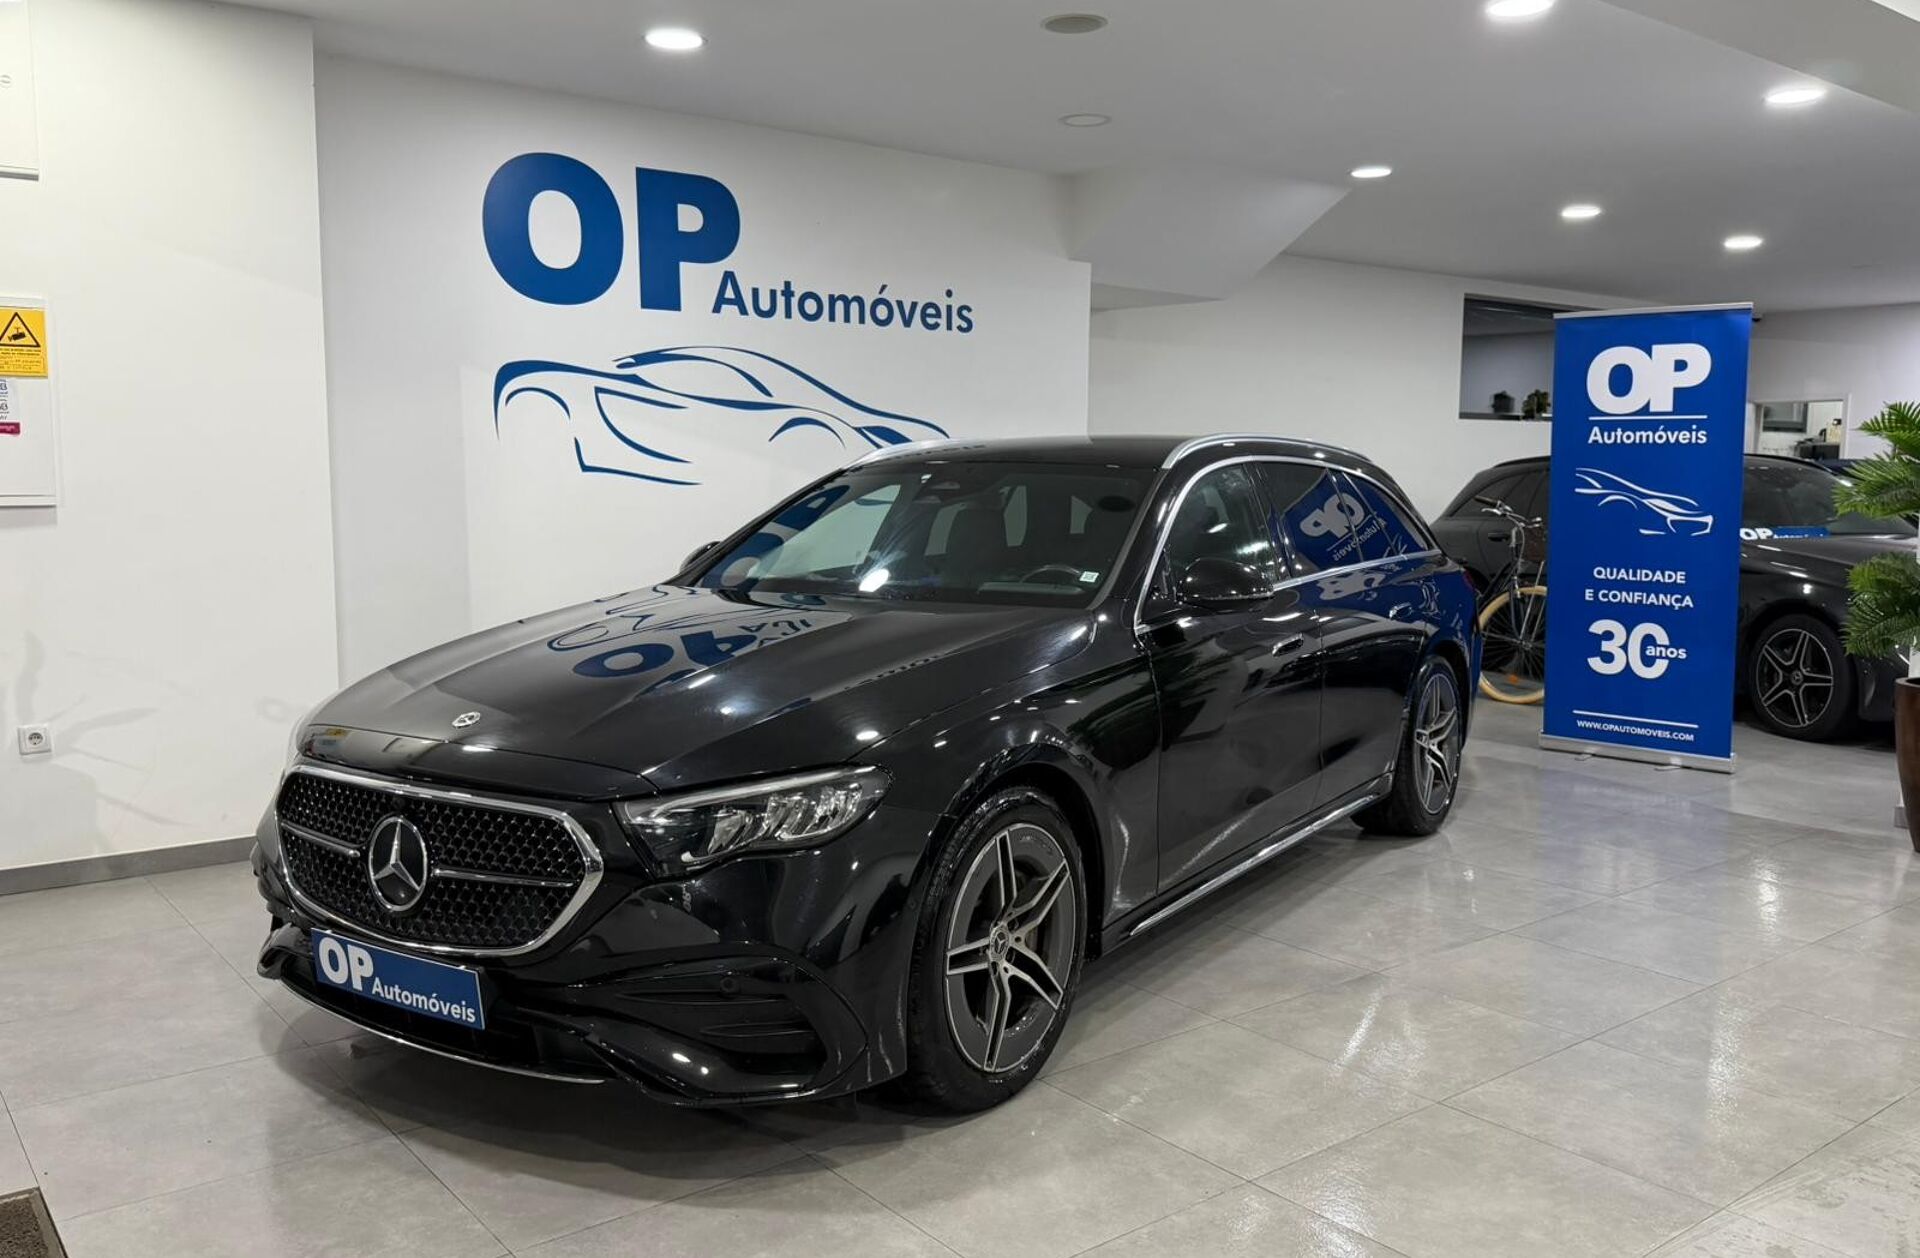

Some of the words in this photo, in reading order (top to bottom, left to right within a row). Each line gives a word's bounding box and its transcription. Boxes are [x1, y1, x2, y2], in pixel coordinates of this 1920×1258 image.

[482, 152, 740, 312] OP
[711, 269, 974, 334] Automóveis
[1586, 342, 1712, 415] OP
[1588, 425, 1708, 444] Automóveis
[1740, 527, 1773, 541] OP
[1593, 566, 1686, 584] QUALIDADE
[1584, 588, 1594, 601] E
[1598, 589, 1694, 610] CONFIANÇA
[1587, 619, 1670, 679] 30
[1645, 645, 1687, 660] anos
[1576, 719, 1695, 742] WWW.OPAUTOMOVEIS.COM
[318, 936, 374, 992] OP
[372, 976, 476, 1023] Automóveis
